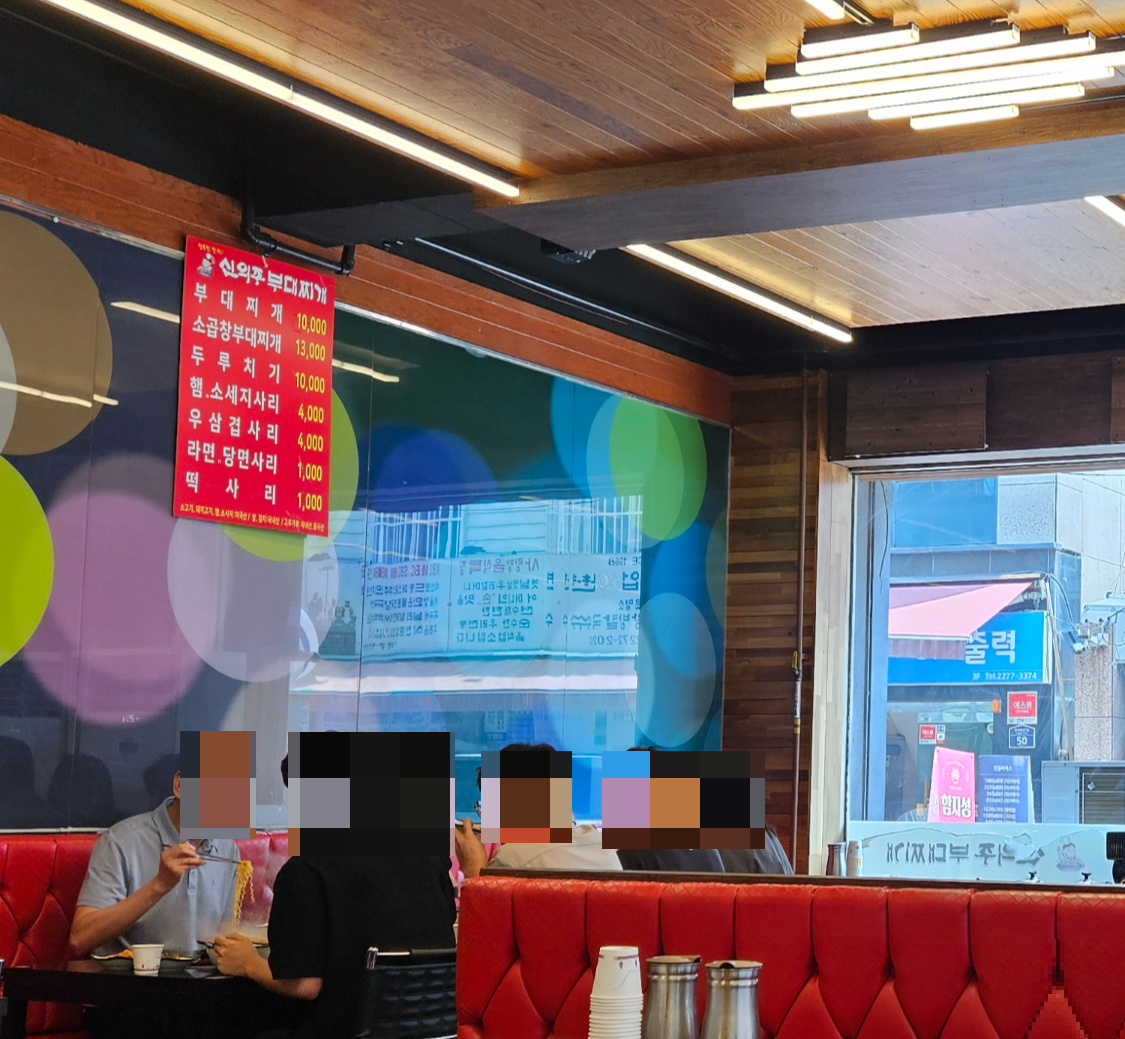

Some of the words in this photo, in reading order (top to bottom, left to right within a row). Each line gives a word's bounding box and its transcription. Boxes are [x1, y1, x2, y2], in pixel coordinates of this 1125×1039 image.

[219, 257, 265, 286] 신의주
[267, 270, 327, 305] 부대찌개
[296, 312, 327, 336] 10,000
[192, 315, 282, 354] 소곱창부대찌개
[295, 339, 326, 362] 13,000
[295, 372, 325, 394] 10,000
[298, 403, 325, 424] 4,000
[297, 431, 324, 453] 4,000
[297, 462, 323, 482] 1,000
[297, 492, 323, 512] 1,000
[1016, 736, 1028, 746] 50
